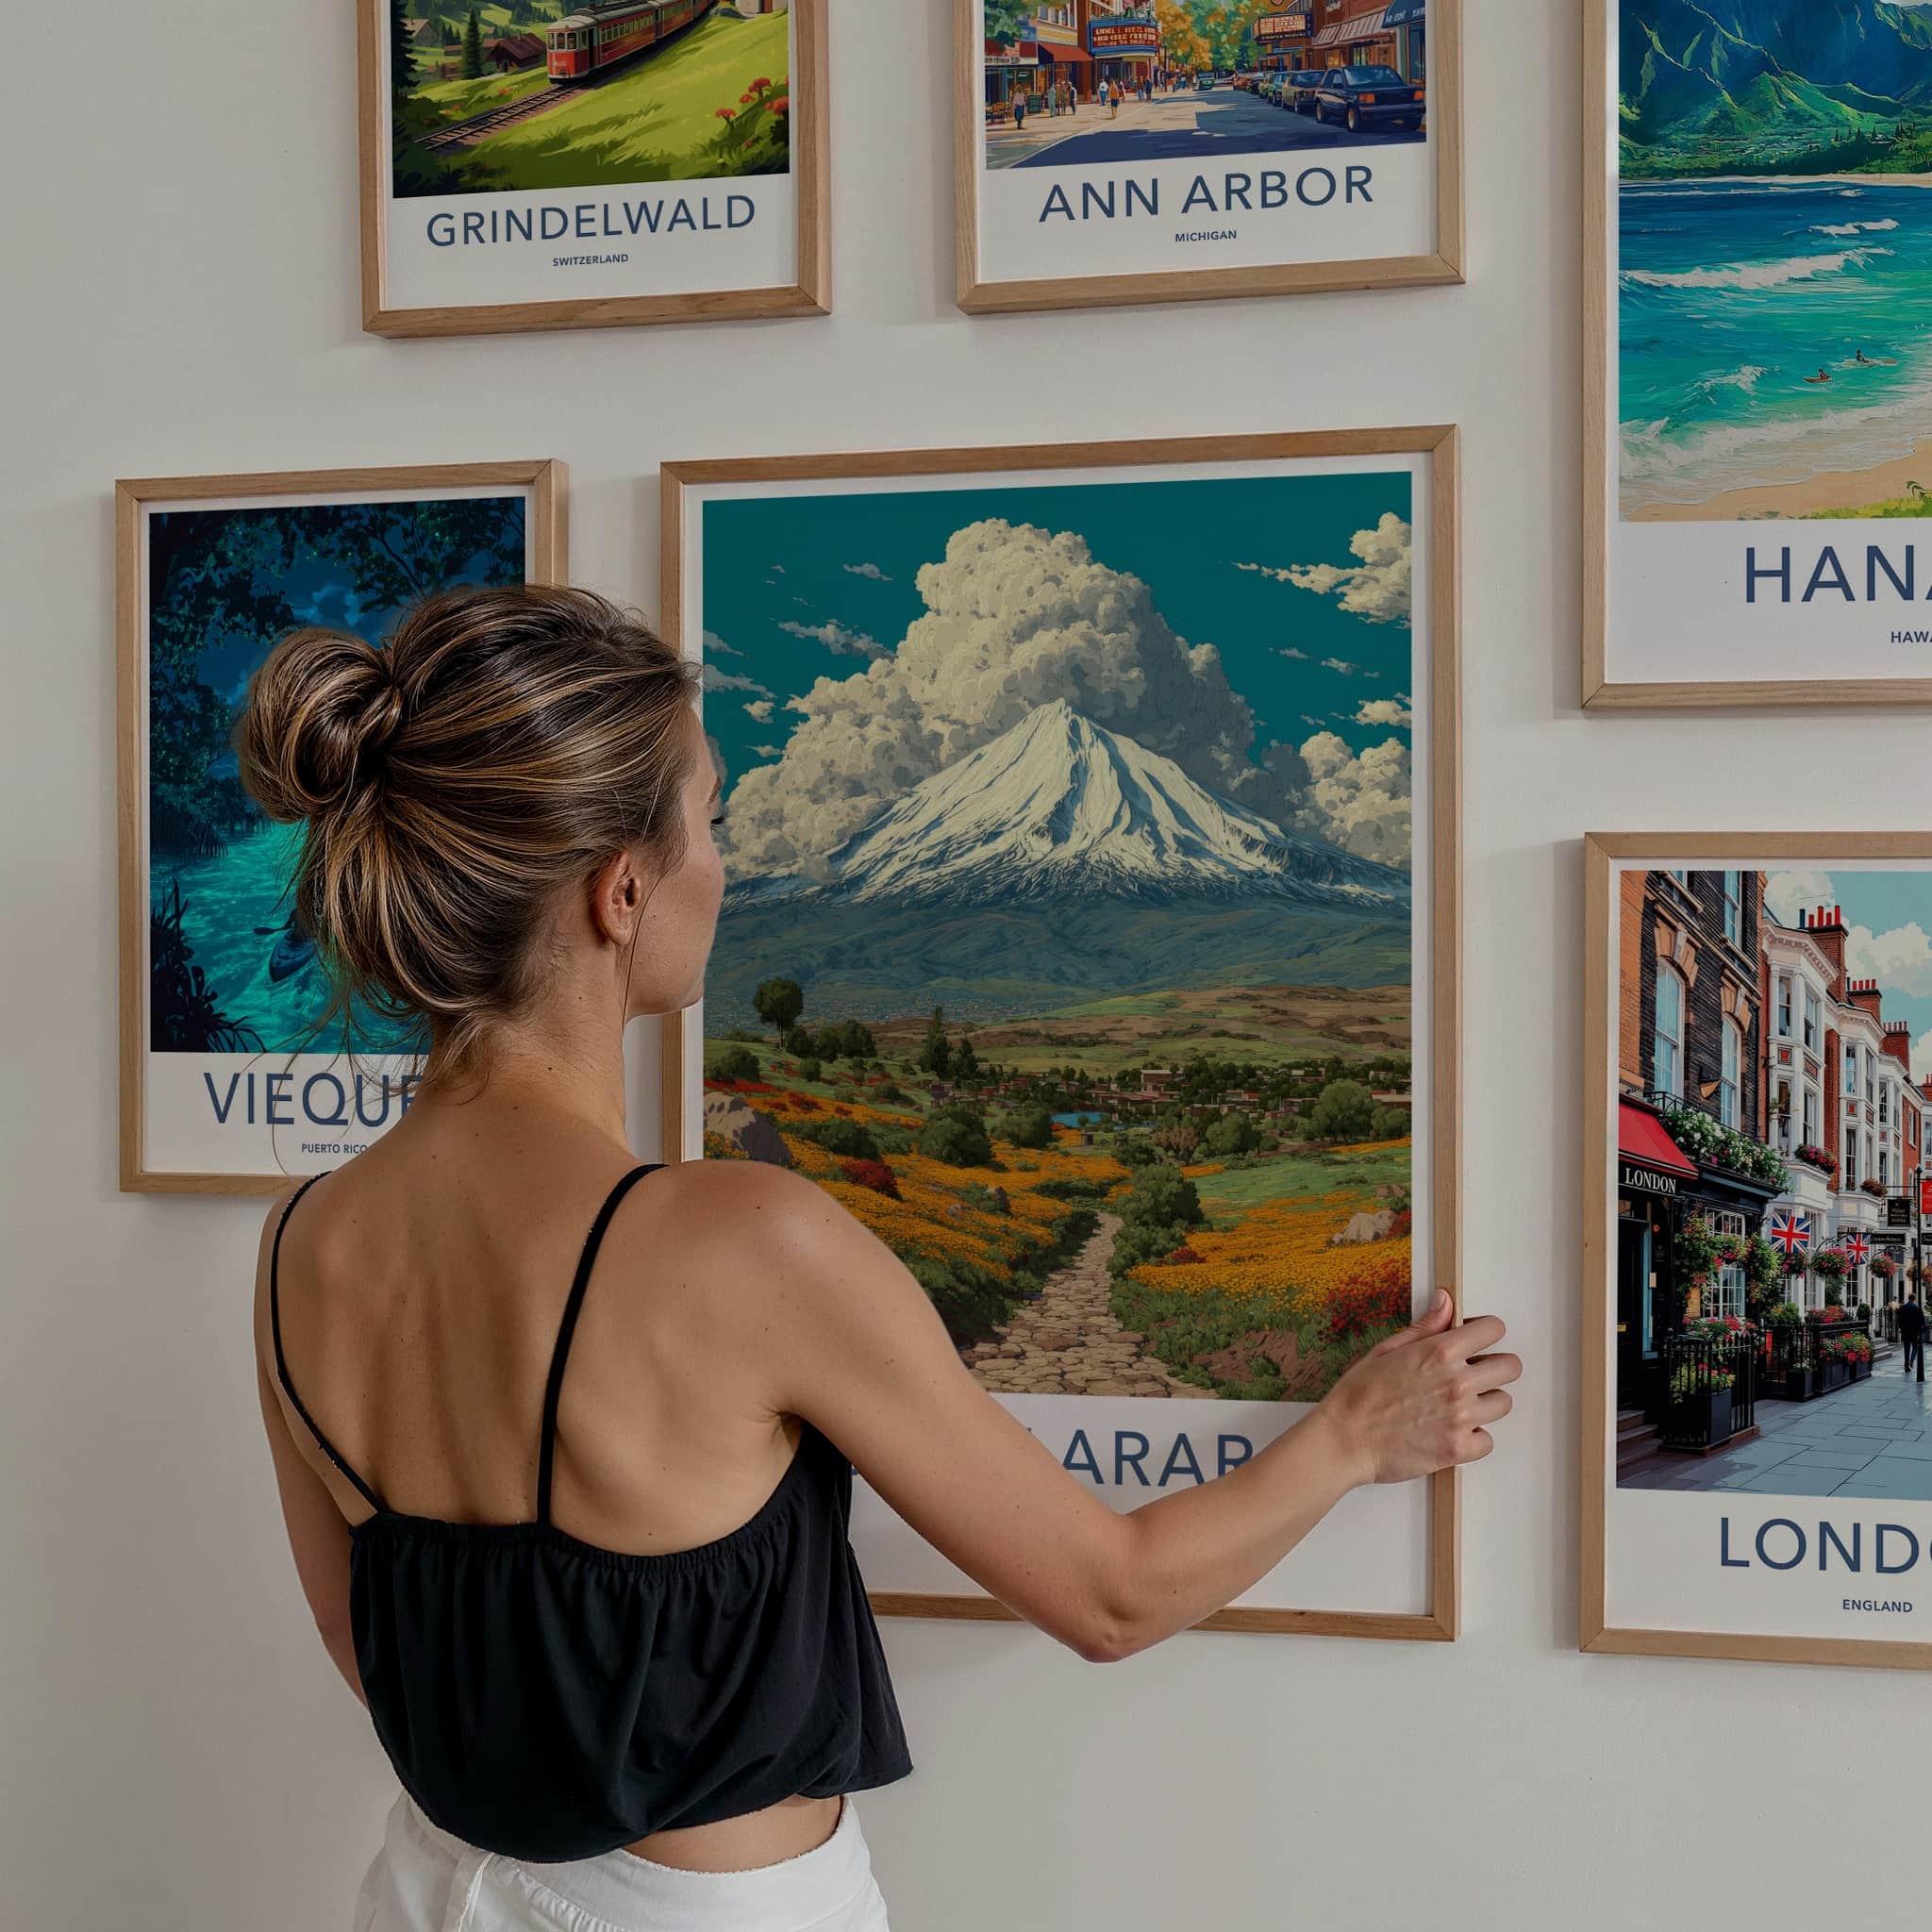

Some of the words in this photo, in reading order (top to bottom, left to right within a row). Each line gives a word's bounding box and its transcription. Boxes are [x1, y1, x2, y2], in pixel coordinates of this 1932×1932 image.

[1039, 178, 1159, 223] ANN
[1181, 165, 1374, 214] ARBOR
[427, 195, 756, 247] GRINDELWALD
[1174, 230, 1238, 242] MICHIGAN
[552, 254, 629, 267] SWITZERLAND
[1746, 544, 1932, 603] HAN
[1890, 631, 1932, 643] HAW
[301, 1143, 341, 1154] PUERTO
[1624, 1167, 1676, 1194] LONDON
[1721, 1517, 1932, 1574] LOND
[1842, 1599, 1913, 1613] ENGLAND
